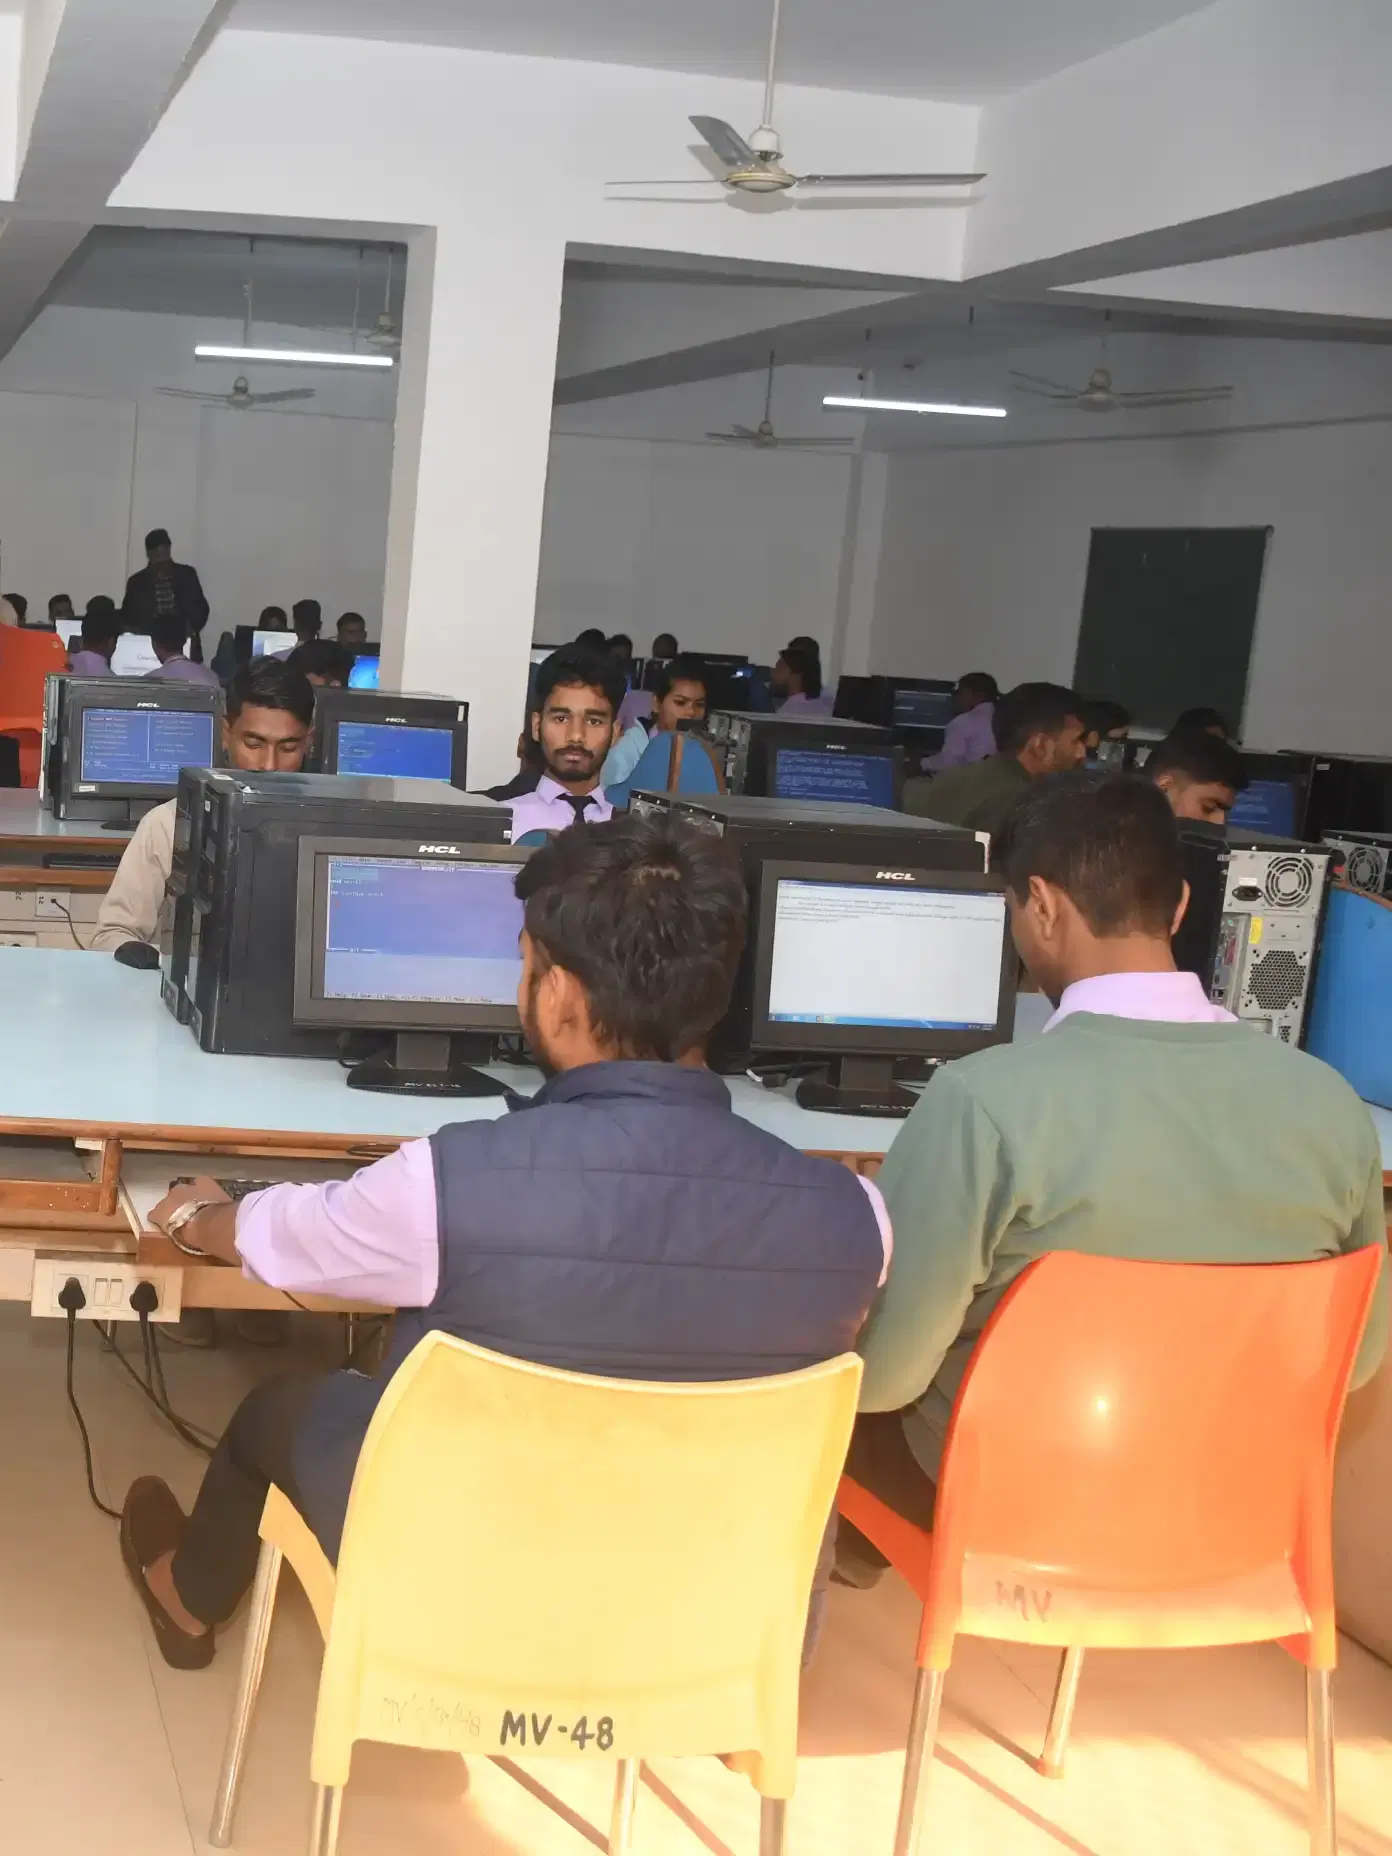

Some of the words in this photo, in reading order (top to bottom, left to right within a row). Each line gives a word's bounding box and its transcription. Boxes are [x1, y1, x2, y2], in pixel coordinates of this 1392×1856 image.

[418, 845, 461, 854] HCL
[875, 871, 916, 881] HCL
[499, 1709, 614, 1751] MV-48
